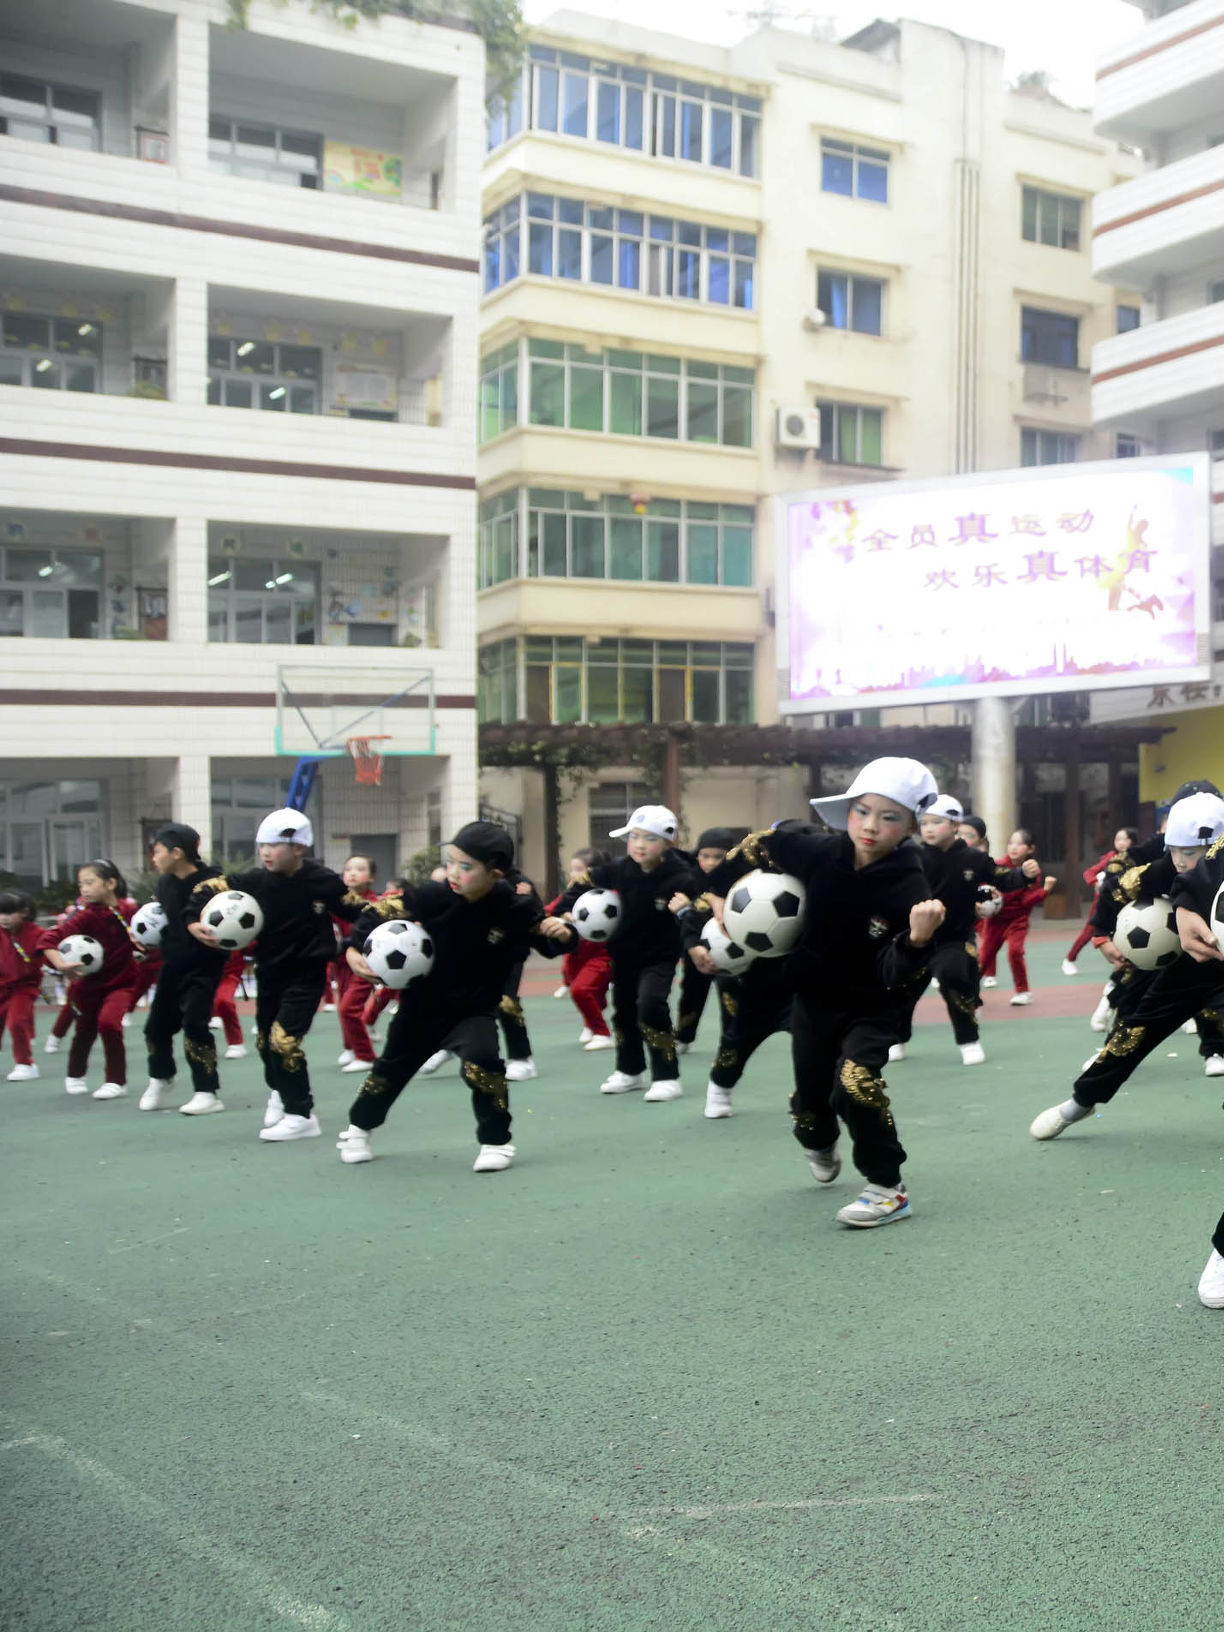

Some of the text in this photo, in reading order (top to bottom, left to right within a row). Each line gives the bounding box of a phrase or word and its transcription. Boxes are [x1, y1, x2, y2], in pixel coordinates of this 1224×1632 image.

[862, 509, 1095, 552] 全员真运动
[923, 548, 1159, 591] 欢乐真体育
